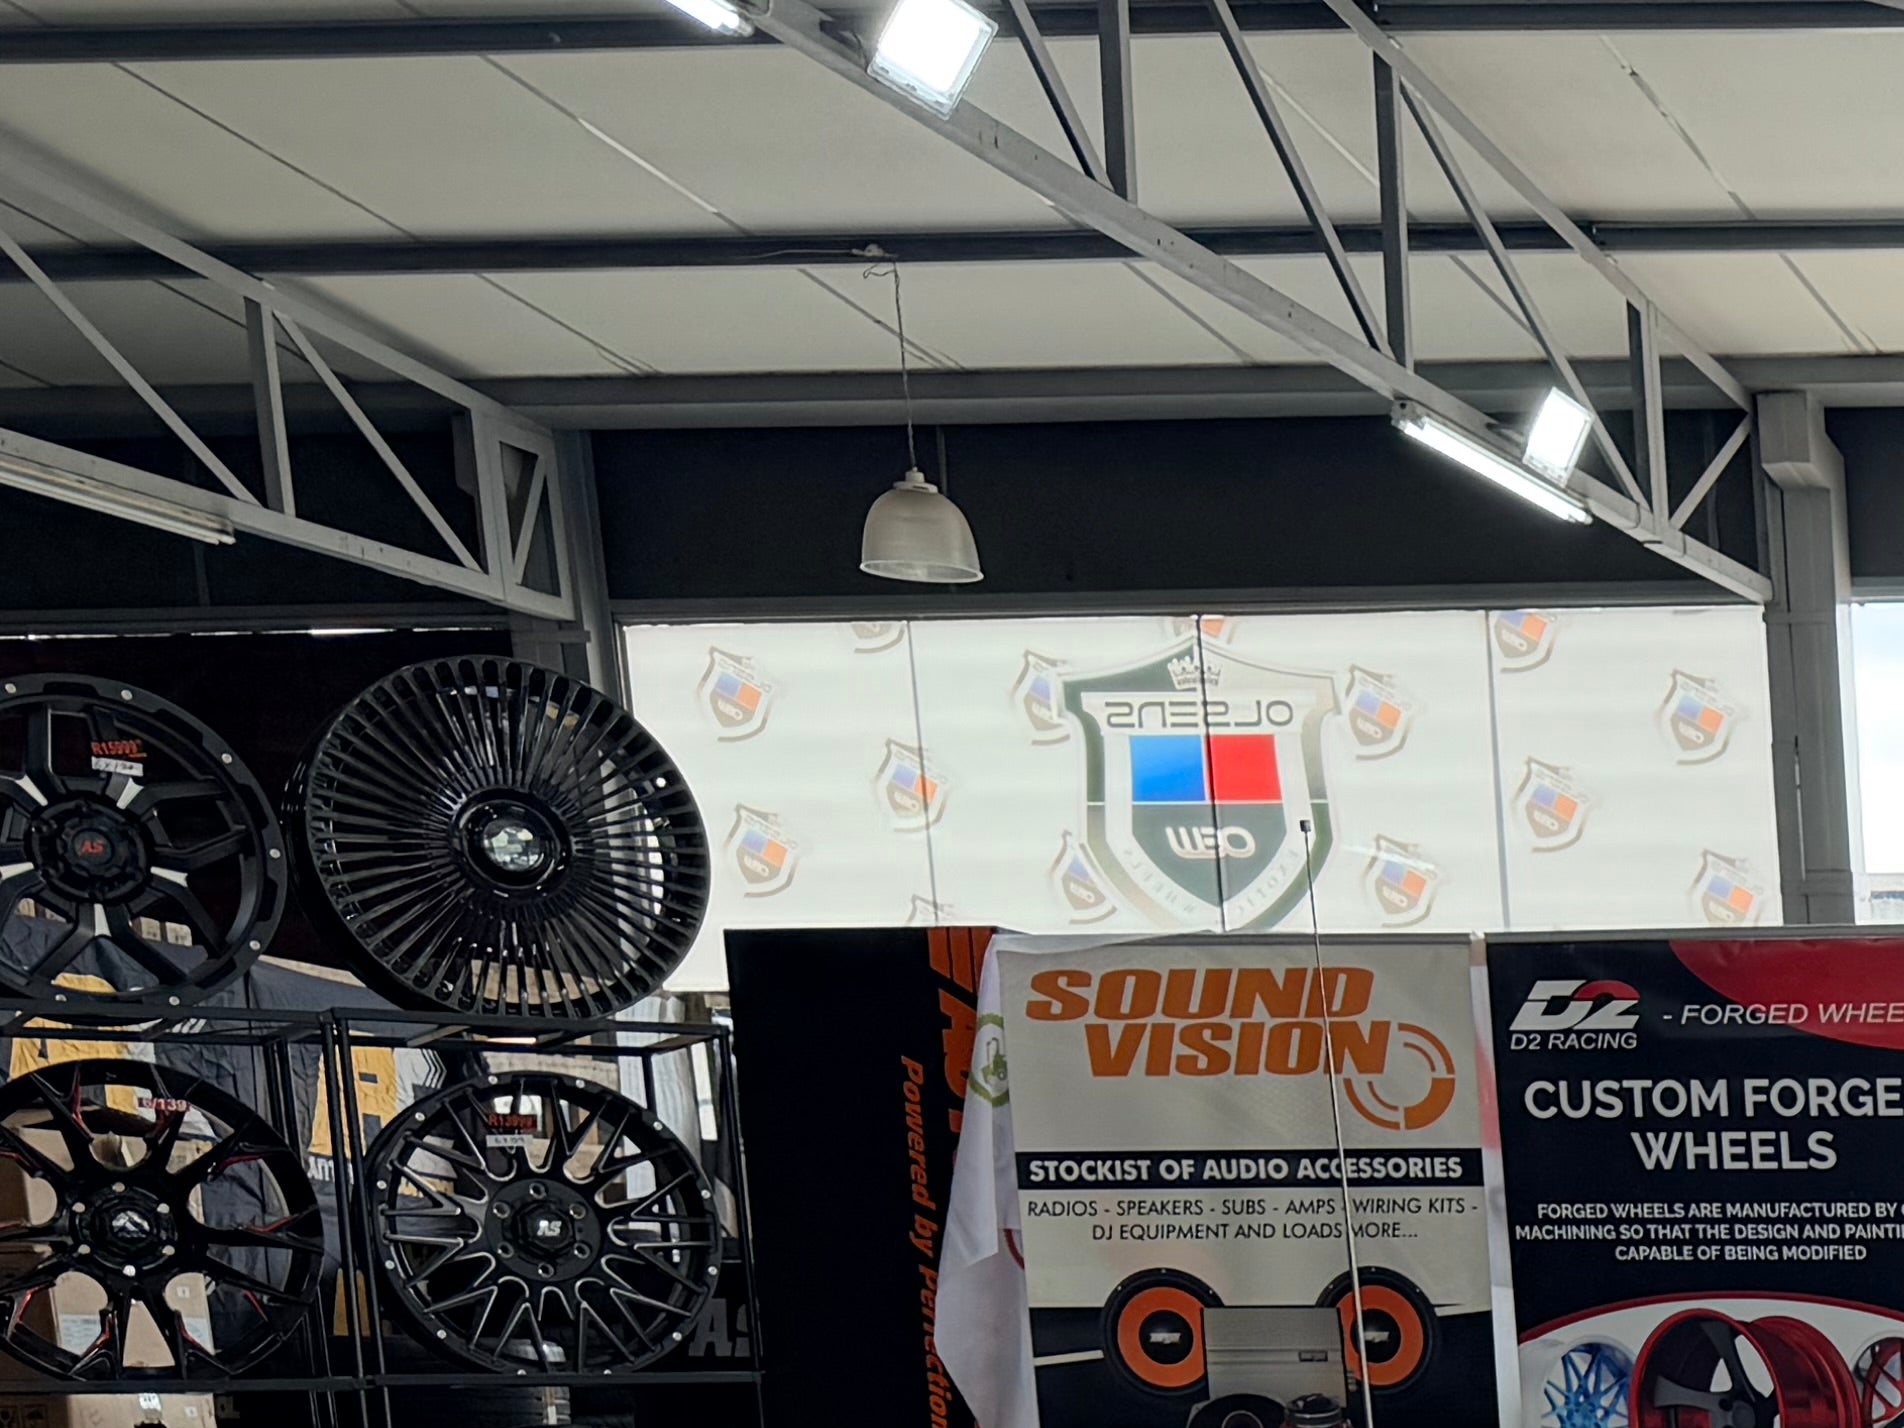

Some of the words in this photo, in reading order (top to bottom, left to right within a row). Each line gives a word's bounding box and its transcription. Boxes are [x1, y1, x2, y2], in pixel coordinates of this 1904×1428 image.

[1026, 967, 1374, 1020] SOUND
[1509, 980, 1641, 1031] D2
[1681, 1004, 1809, 1024] FORGED
[1085, 1021, 1391, 1076] VISION
[1510, 1034, 1541, 1050] D2
[1548, 1033, 1637, 1049] RACING
[1524, 1079, 1729, 1119] CUSTOM
[1631, 1131, 1837, 1170] WHEELS
[1030, 1160, 1150, 1182] STOCKIST
[1159, 1160, 1195, 1180] OF
[1203, 1159, 1288, 1179] AUDIO
[1297, 1156, 1462, 1179] ACCESSORIES
[1027, 1200, 1098, 1217] RADIOS
[1117, 1200, 1203, 1216] SPEAKERS
[1221, 1200, 1266, 1215] SUBS
[1285, 1199, 1335, 1215] AMPS
[1352, 1198, 1421, 1214] WIRING
[1428, 1198, 1465, 1213] KITS
[1537, 1204, 1607, 1219] FORGED
[1611, 1203, 1684, 1218] WHEELS
[1689, 1203, 1722, 1218] ARE
[1726, 1203, 1870, 1218] MANUFACTURED
[1875, 1202, 1897, 1217] BY
[1092, 1225, 1113, 1241] DJ
[1120, 1224, 1228, 1240] EQUIPMENT
[1234, 1223, 1276, 1239] AND
[1283, 1223, 1342, 1239] LOADS
[1516, 1225, 1616, 1240] MACHINING
[1619, 1224, 1643, 1239] SO
[1647, 1224, 1692, 1239] THAT
[1697, 1224, 1729, 1239] THE
[1734, 1224, 1799, 1239] DESIGN
[1803, 1224, 1840, 1239] AND
[1615, 1245, 1693, 1261] CAPABLE
[1697, 1245, 1721, 1260] OF
[1725, 1245, 1778, 1260] BEING
[1782, 1245, 1866, 1260] MODIFIED
